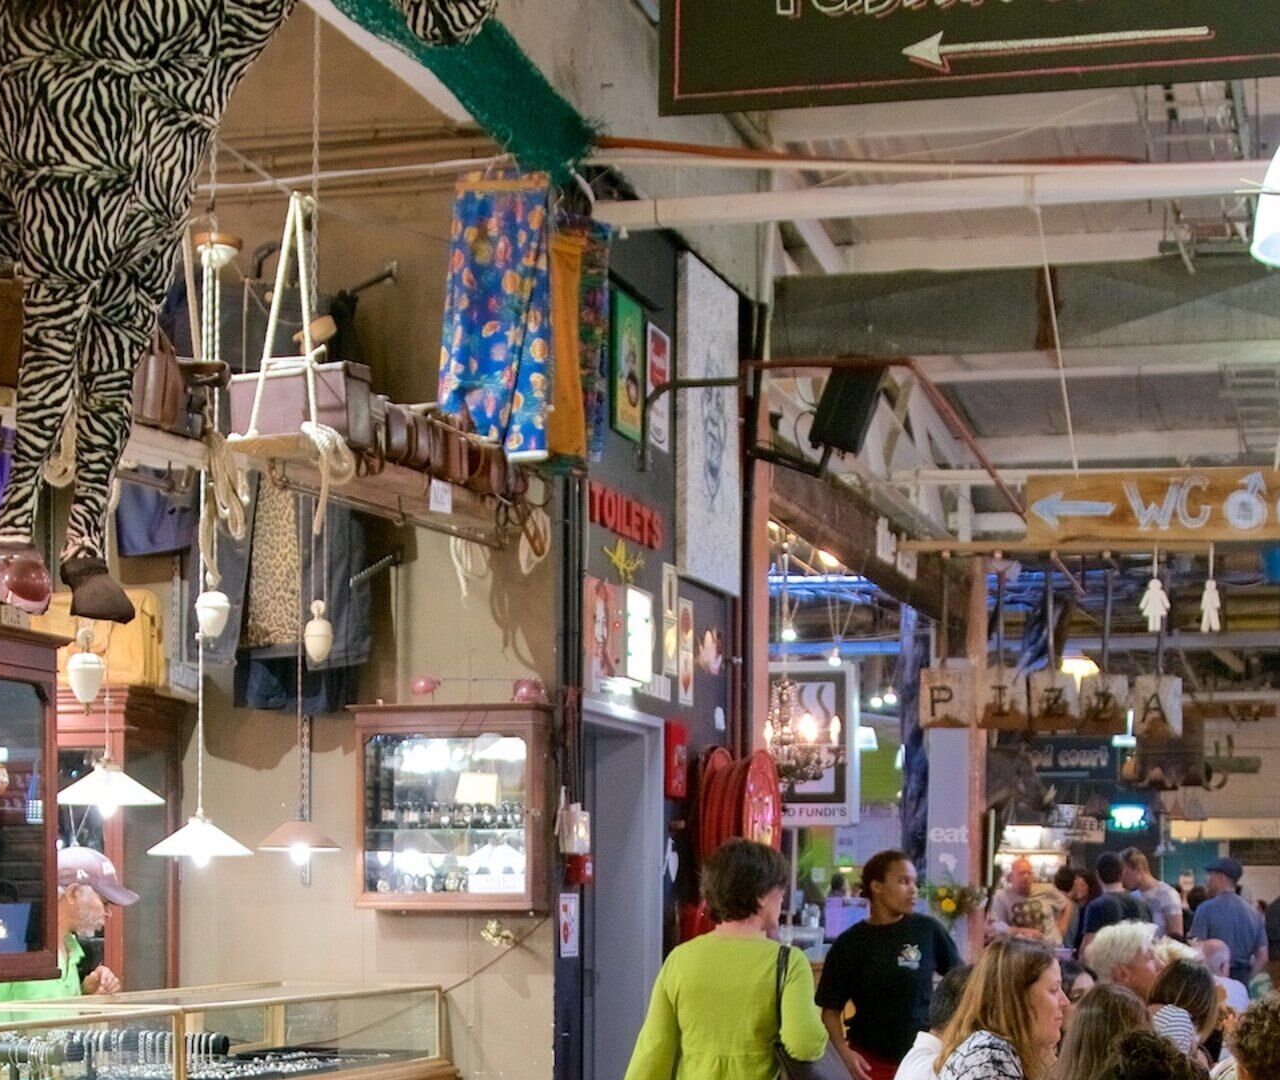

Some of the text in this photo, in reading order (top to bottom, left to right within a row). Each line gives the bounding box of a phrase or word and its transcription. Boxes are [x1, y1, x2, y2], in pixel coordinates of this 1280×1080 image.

[1123, 475, 1212, 531] WC
[590, 482, 664, 550] TOILETS
[1058, 745, 1110, 768] court
[799, 806, 847, 818] FUNDI'S
[930, 825, 969, 843] eat
